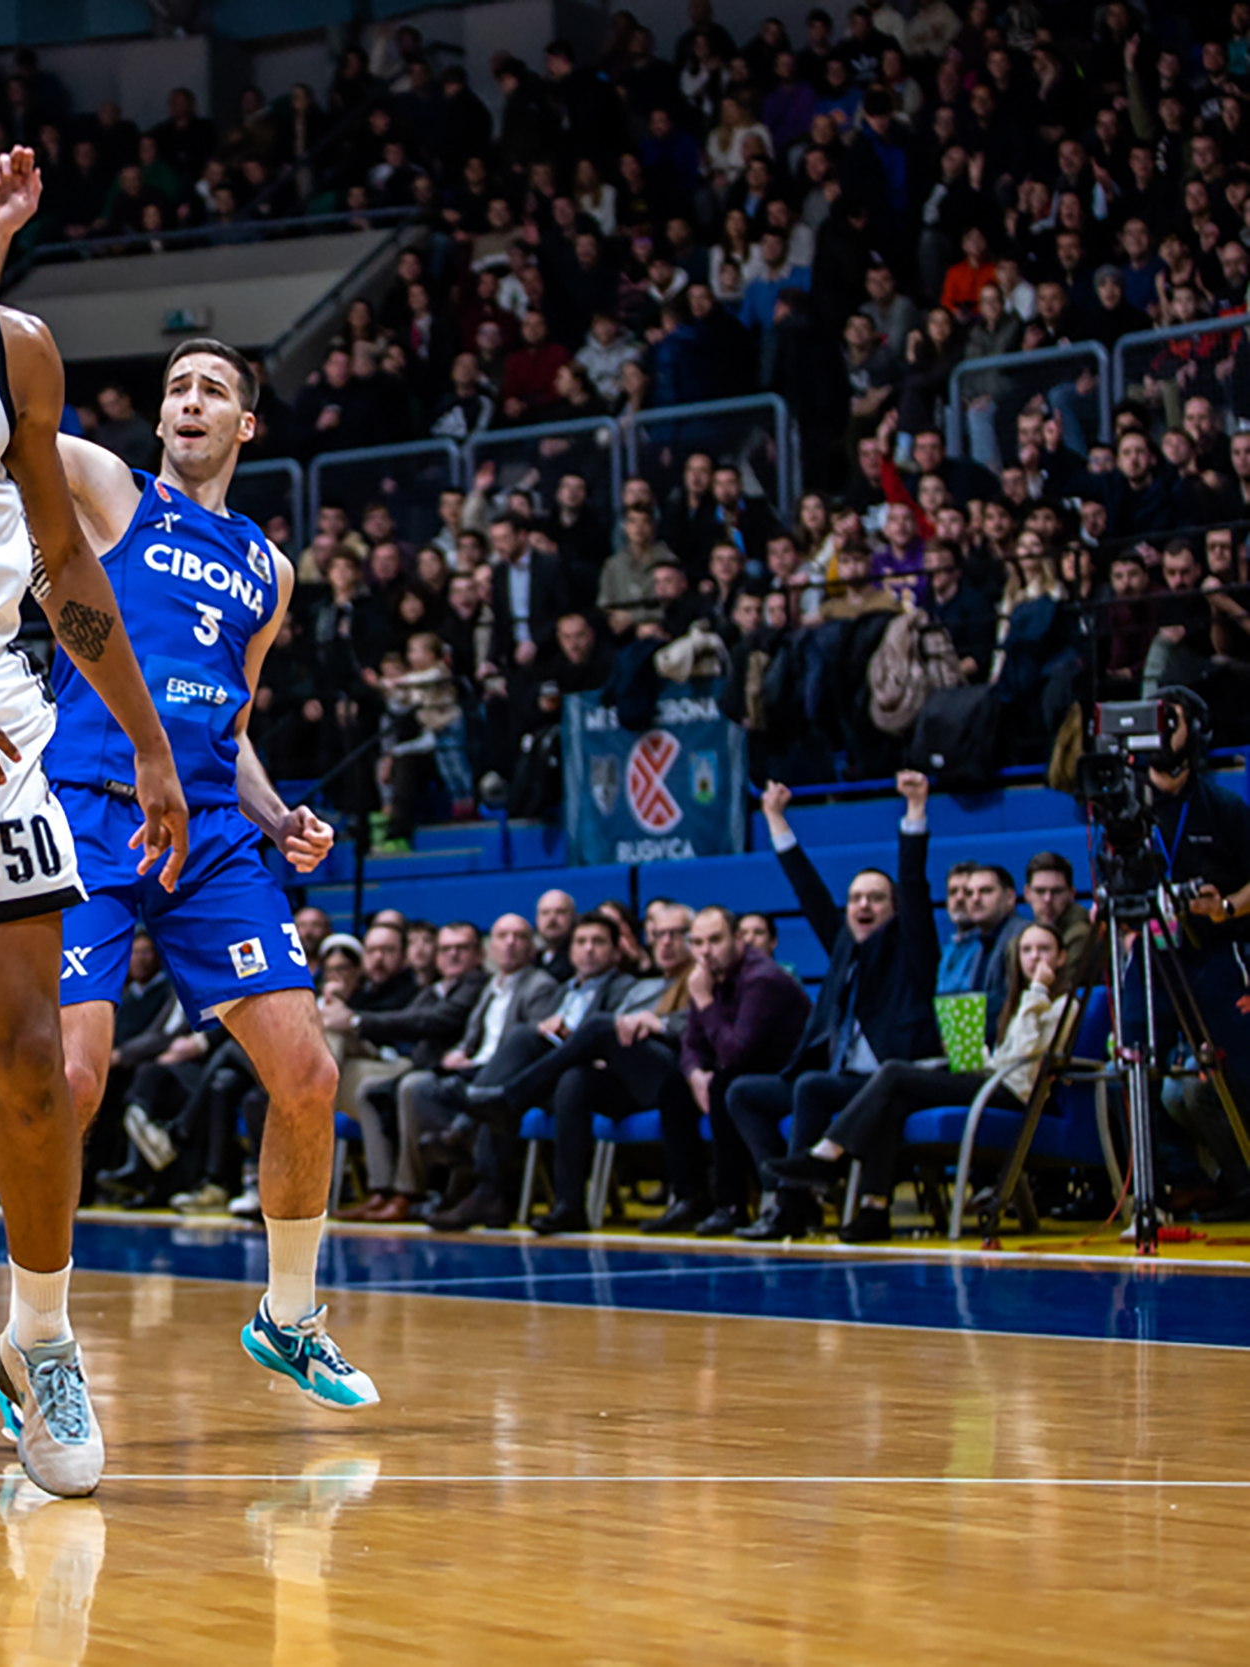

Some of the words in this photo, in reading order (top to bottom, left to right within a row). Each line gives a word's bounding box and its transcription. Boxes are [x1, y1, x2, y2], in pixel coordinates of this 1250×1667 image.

[143, 543, 264, 620] CIBONA
[193, 602, 223, 647] 3
[280, 922, 308, 967] 3
